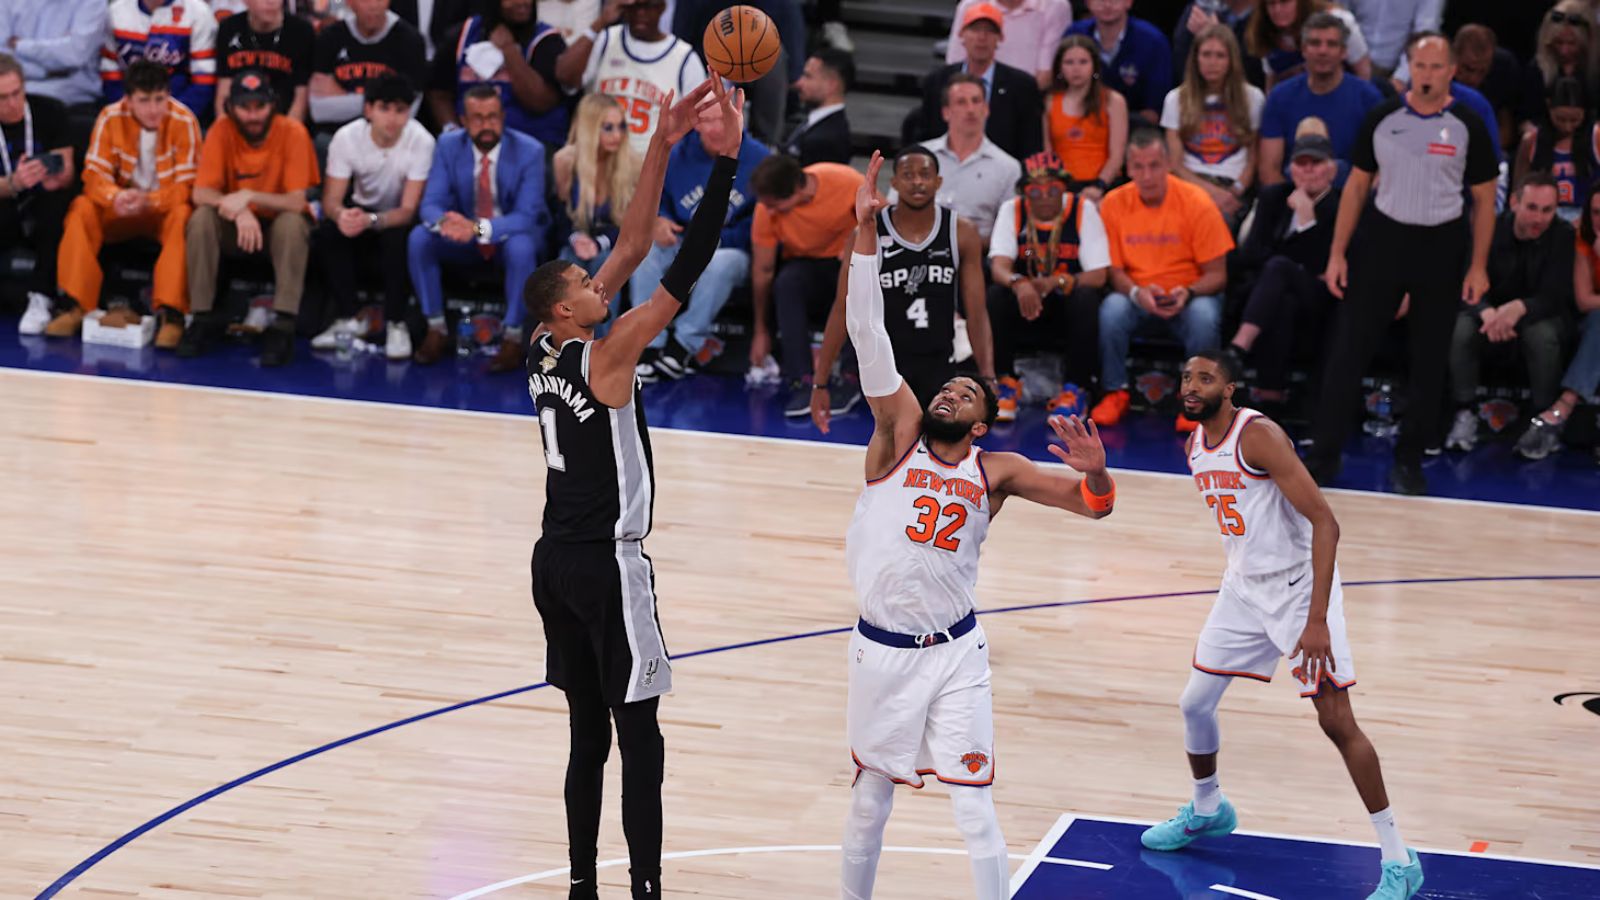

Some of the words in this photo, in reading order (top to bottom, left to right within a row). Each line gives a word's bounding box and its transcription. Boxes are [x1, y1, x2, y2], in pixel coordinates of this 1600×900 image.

[600, 77, 629, 94] NEW
[614, 96, 651, 135] 5
[906, 297, 929, 329] 4
[527, 372, 595, 423] MBANYAMA
[540, 406, 566, 472] 1
[903, 468, 945, 493] NEW
[943, 477, 984, 510] YORK
[905, 495, 968, 552] 32
